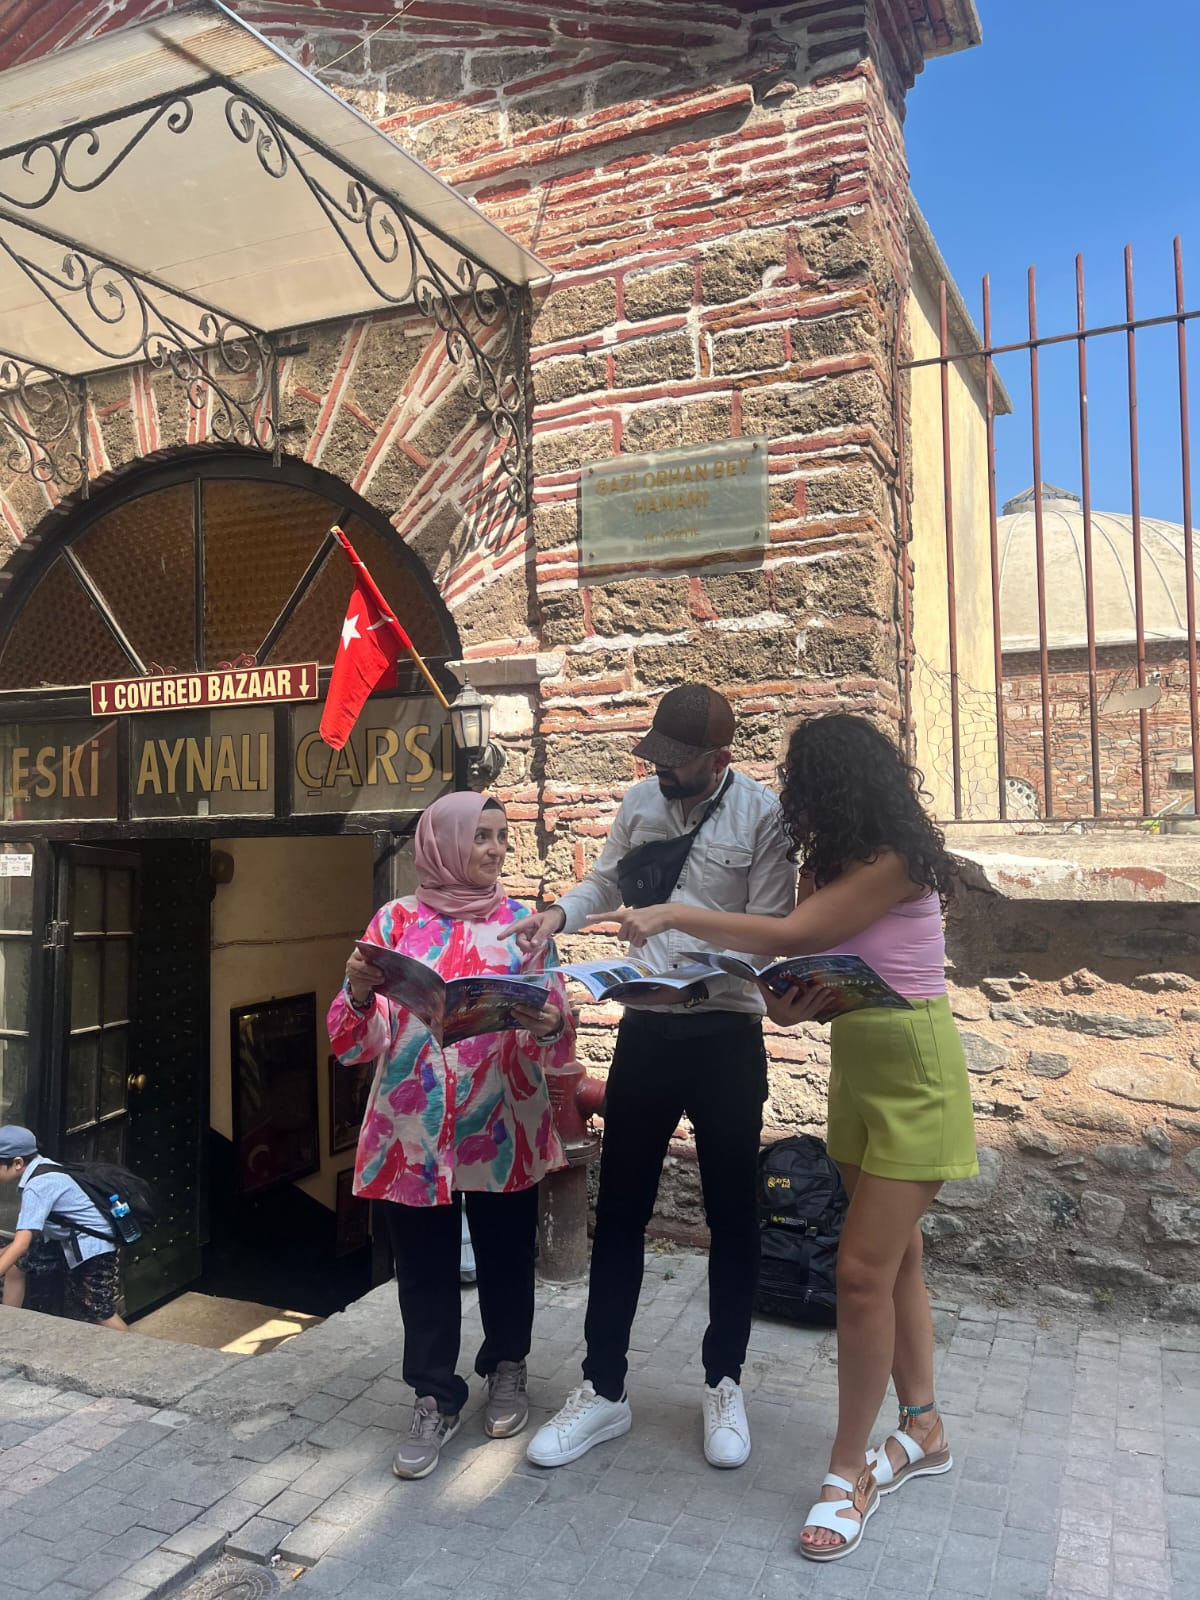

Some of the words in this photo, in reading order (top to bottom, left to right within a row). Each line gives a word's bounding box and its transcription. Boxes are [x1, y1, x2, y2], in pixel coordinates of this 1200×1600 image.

[643, 464, 709, 489] ORHAN
[713, 457, 751, 479] BEY
[114, 677, 201, 710] COVERED
[207, 669, 291, 701] BAZAAR
[136, 733, 268, 795] AYNALI
